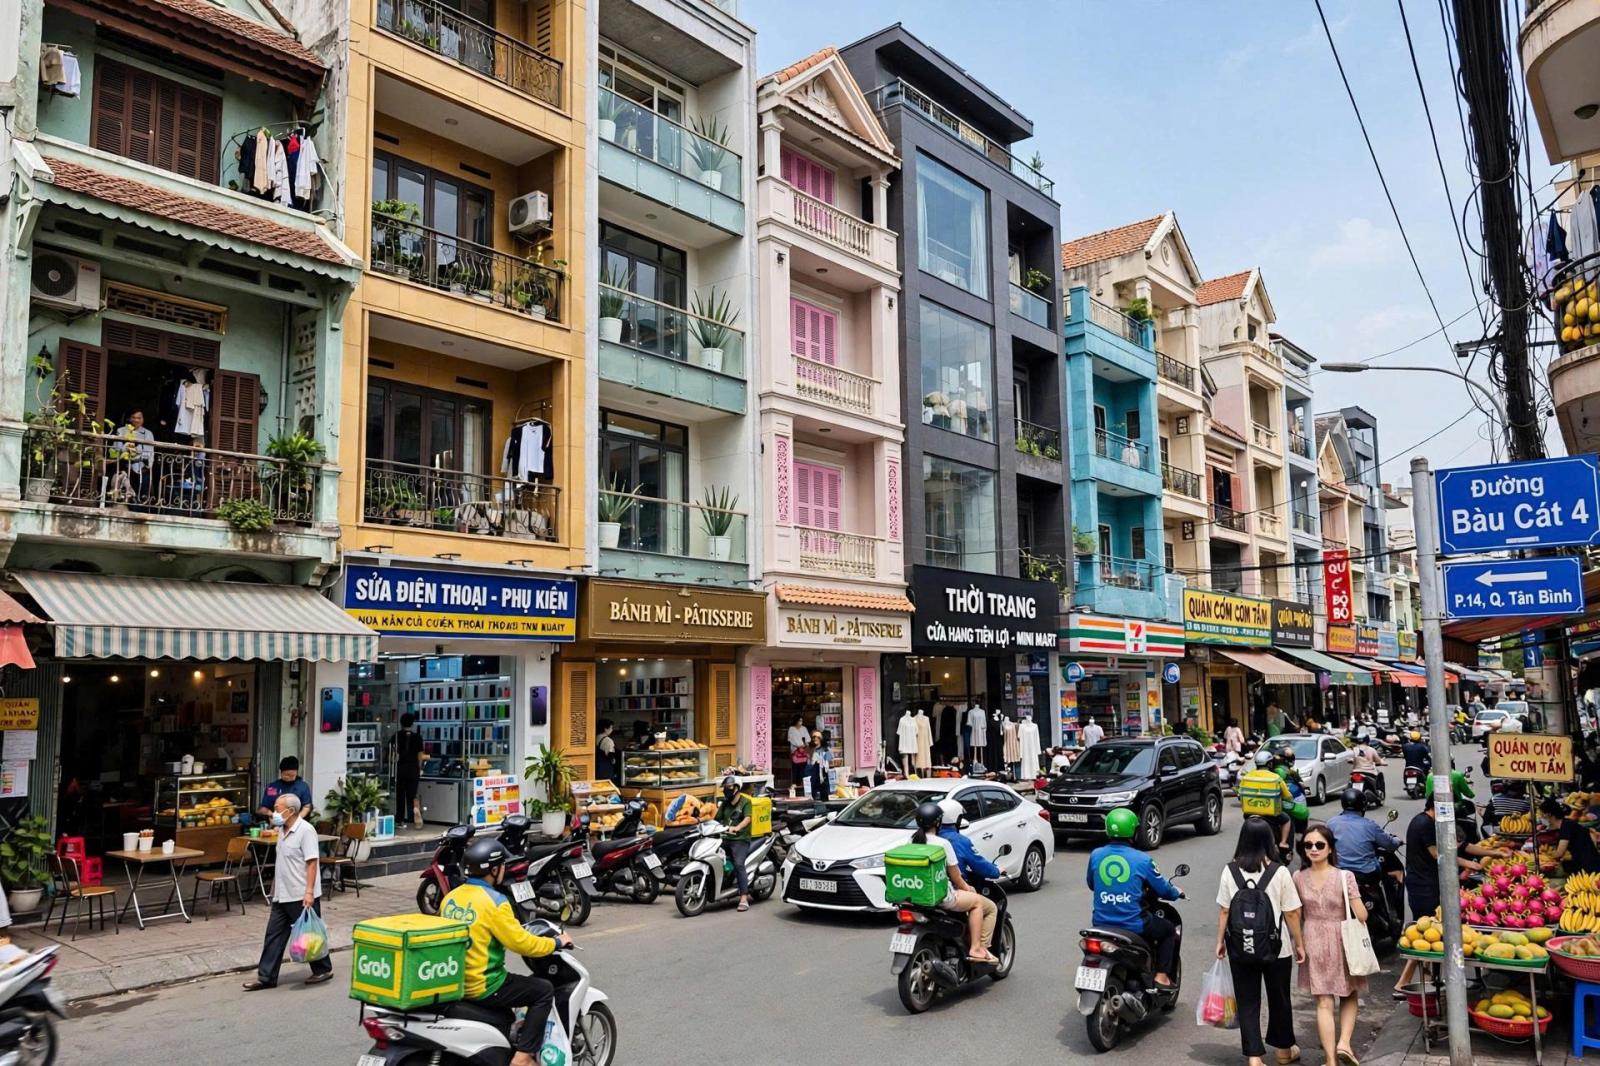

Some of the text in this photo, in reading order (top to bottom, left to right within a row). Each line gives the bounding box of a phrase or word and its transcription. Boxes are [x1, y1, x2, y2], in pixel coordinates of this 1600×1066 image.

[1471, 475, 1544, 497] Đường
[1452, 498, 1589, 535] Bàu Cát 4
[355, 571, 392, 601] SỬA
[396, 577, 437, 608] ĐIỆN
[441, 584, 487, 611] THOẠI
[502, 588, 531, 613] PHỤ
[536, 586, 567, 614] KIỆN
[946, 584, 1037, 619] THỜI TRANG
[1455, 588, 1572, 609] P.14, Q. Tân Bình
[610, 598, 651, 622] BÁNH
[655, 600, 672, 623] MÌ
[684, 603, 753, 628] PÂTISSERIE
[787, 613, 820, 635] BÁNH
[824, 615, 837, 635] MÌ
[847, 617, 903, 639] PÂTISSERIE
[1017, 632, 1034, 646] MINI
[1035, 633, 1057, 647] MART
[1494, 738, 1529, 758] QUÁN
[892, 874, 924, 890] Grab
[358, 954, 391, 979] Grab
[418, 956, 459, 981] Grab
